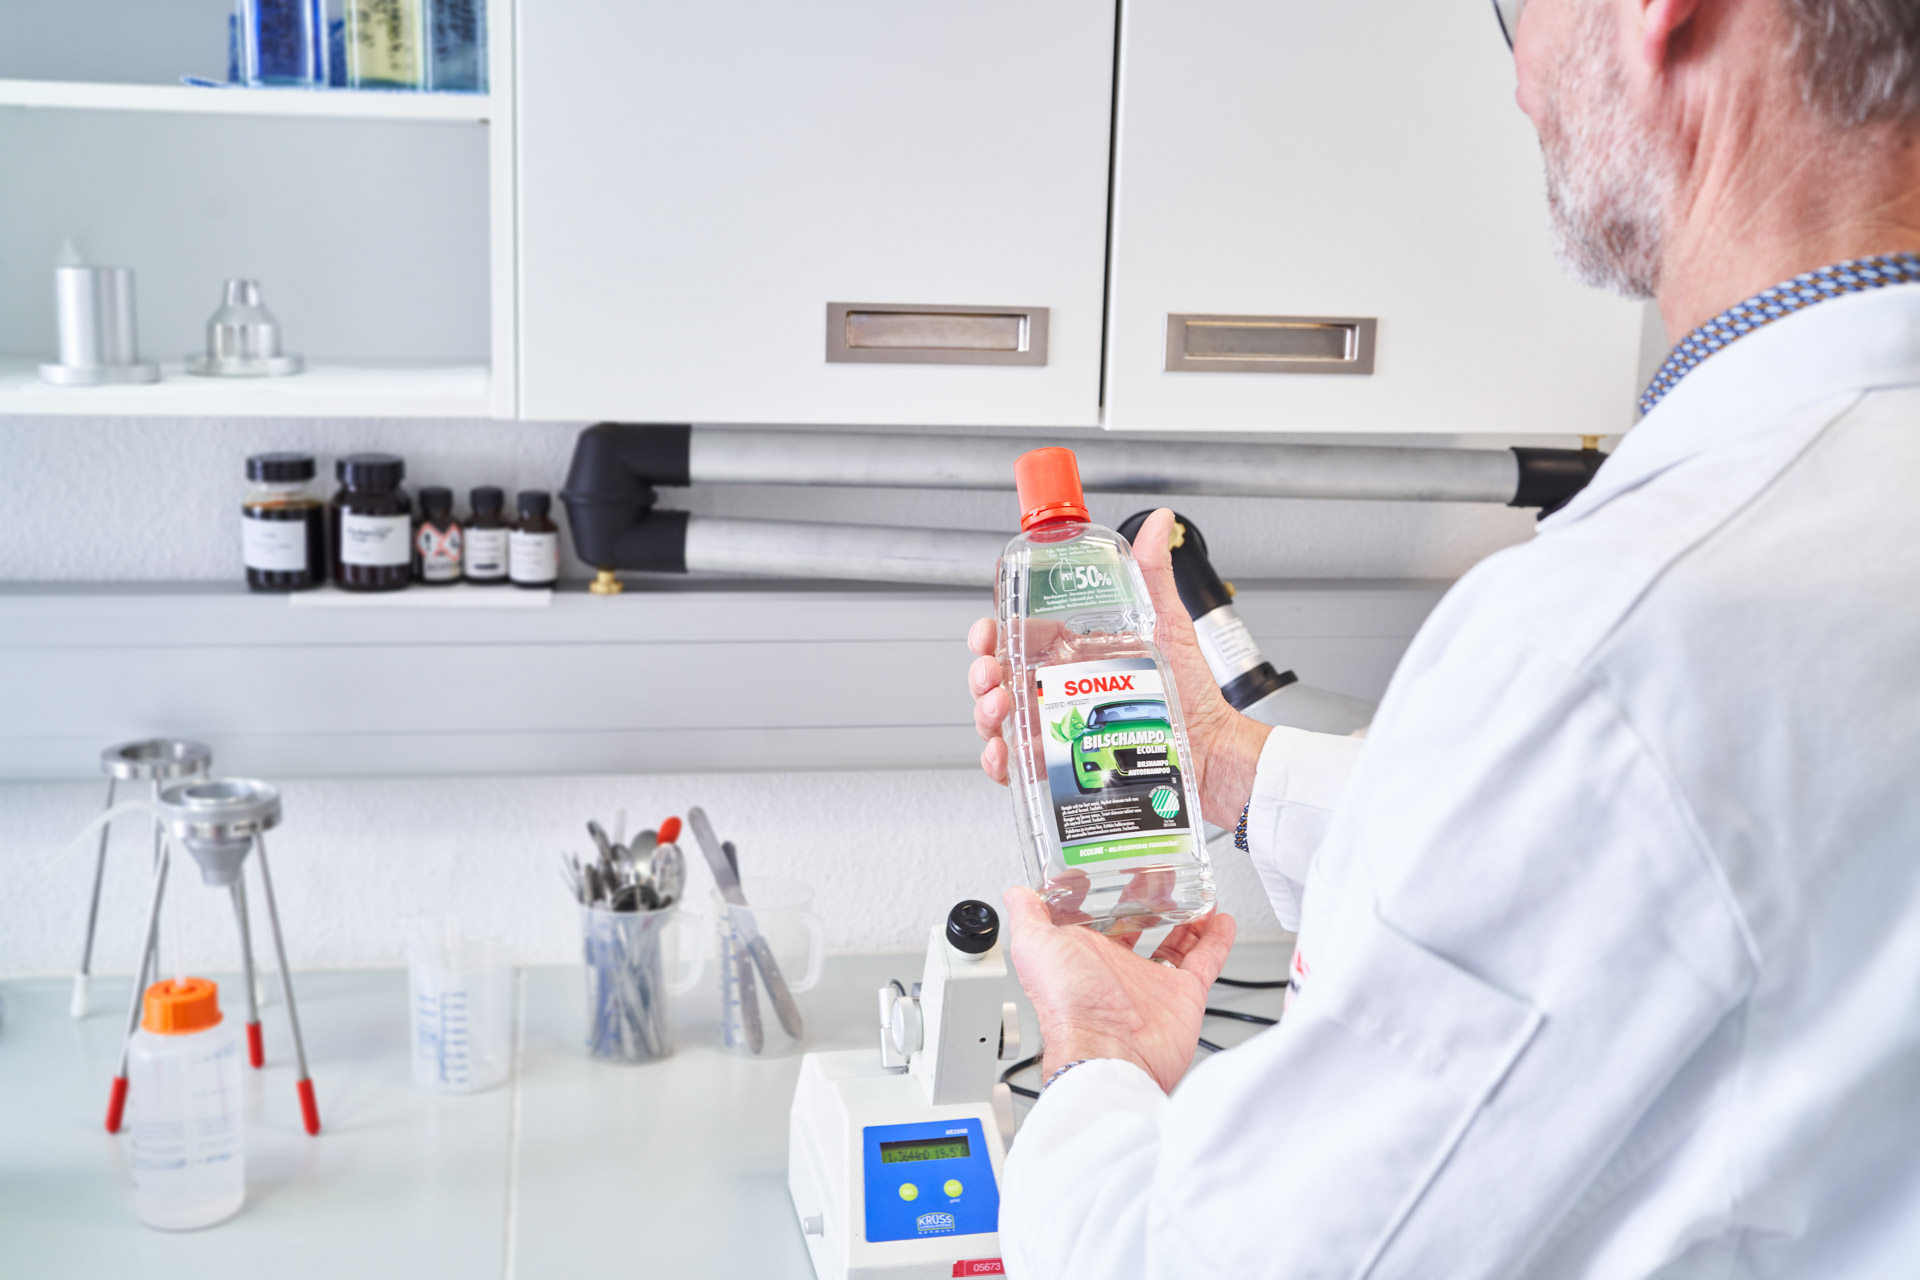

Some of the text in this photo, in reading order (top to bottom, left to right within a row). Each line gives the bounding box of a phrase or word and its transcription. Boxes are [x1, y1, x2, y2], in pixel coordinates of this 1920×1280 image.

[1061, 572, 1074, 581] PET
[1075, 565, 1112, 589] 50%
[1064, 675, 1135, 696] SONAX
[1083, 730, 1166, 750] BILSCHAMPO
[1136, 745, 1168, 755] ECOLINE
[1136, 760, 1170, 768] BILSHAMPO
[1128, 767, 1171, 776] AUTOSHAMPOO
[1079, 846, 1105, 857] ECOLINE
[973, 1262, 1001, 1272] 05673
